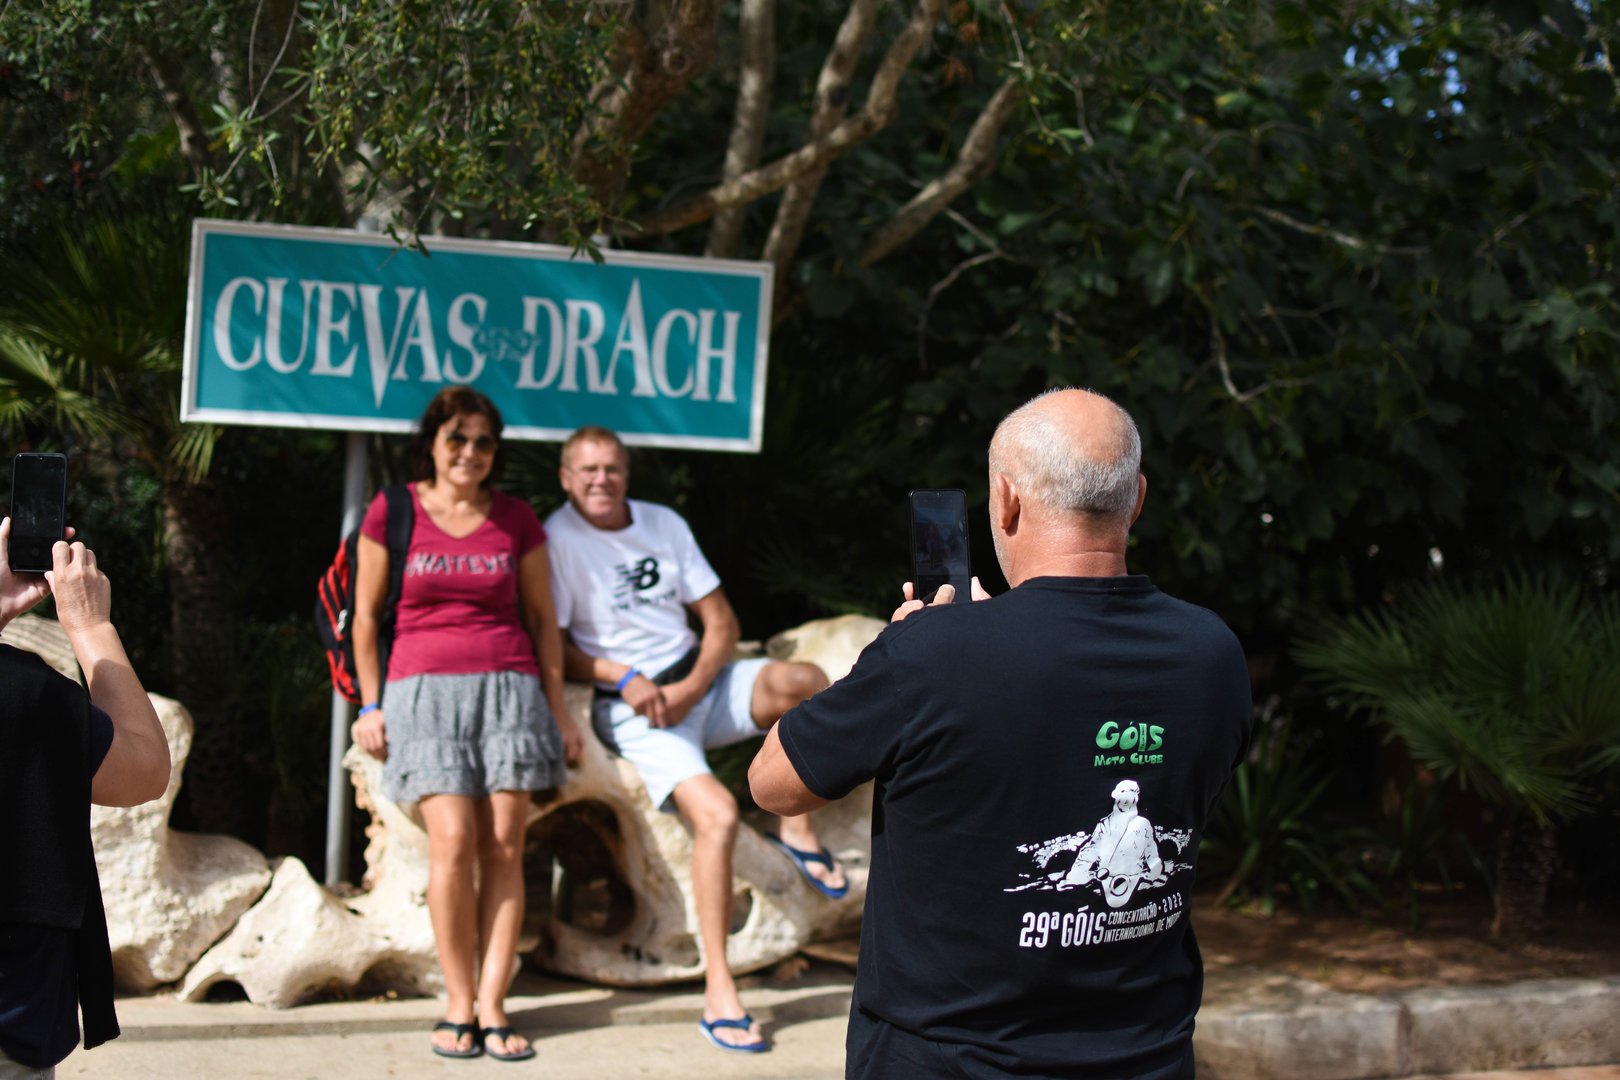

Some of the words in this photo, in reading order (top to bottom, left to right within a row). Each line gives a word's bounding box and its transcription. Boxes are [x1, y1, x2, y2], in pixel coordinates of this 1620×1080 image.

[213, 276, 488, 409] CUEVAS
[515, 276, 742, 403] DRACH
[1095, 720, 1165, 752] GÓIS
[1107, 901, 1158, 925] CONCENTRAÇÃO
[1162, 892, 1183, 913] 2022
[1061, 905, 1107, 948] GÓIS
[1104, 922, 1155, 943] INTERNACIONAL
[1155, 917, 1166, 933] DE
